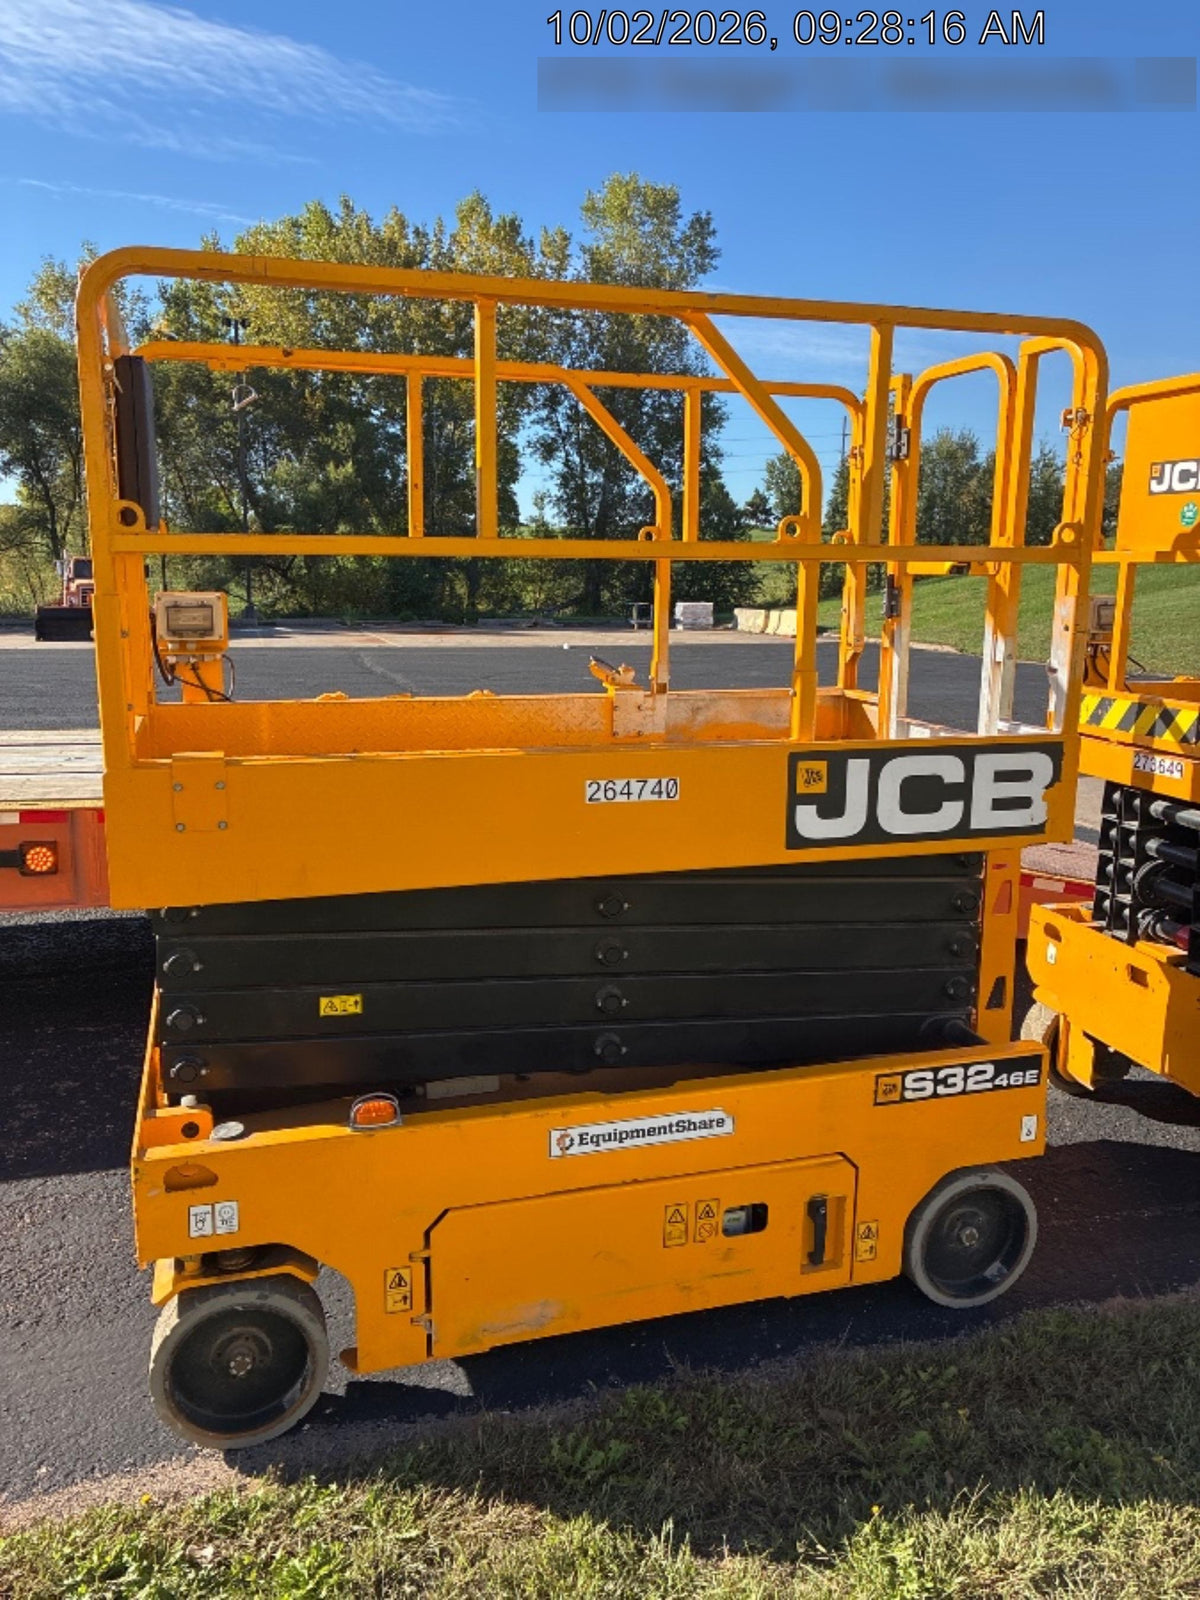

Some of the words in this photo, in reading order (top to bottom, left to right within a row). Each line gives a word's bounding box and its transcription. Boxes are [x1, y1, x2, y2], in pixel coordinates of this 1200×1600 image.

[1150, 460, 1200, 493] JC
[587, 778, 678, 802] 264740
[795, 752, 1053, 840] JCB
[577, 1116, 726, 1147] EquipmentShare
